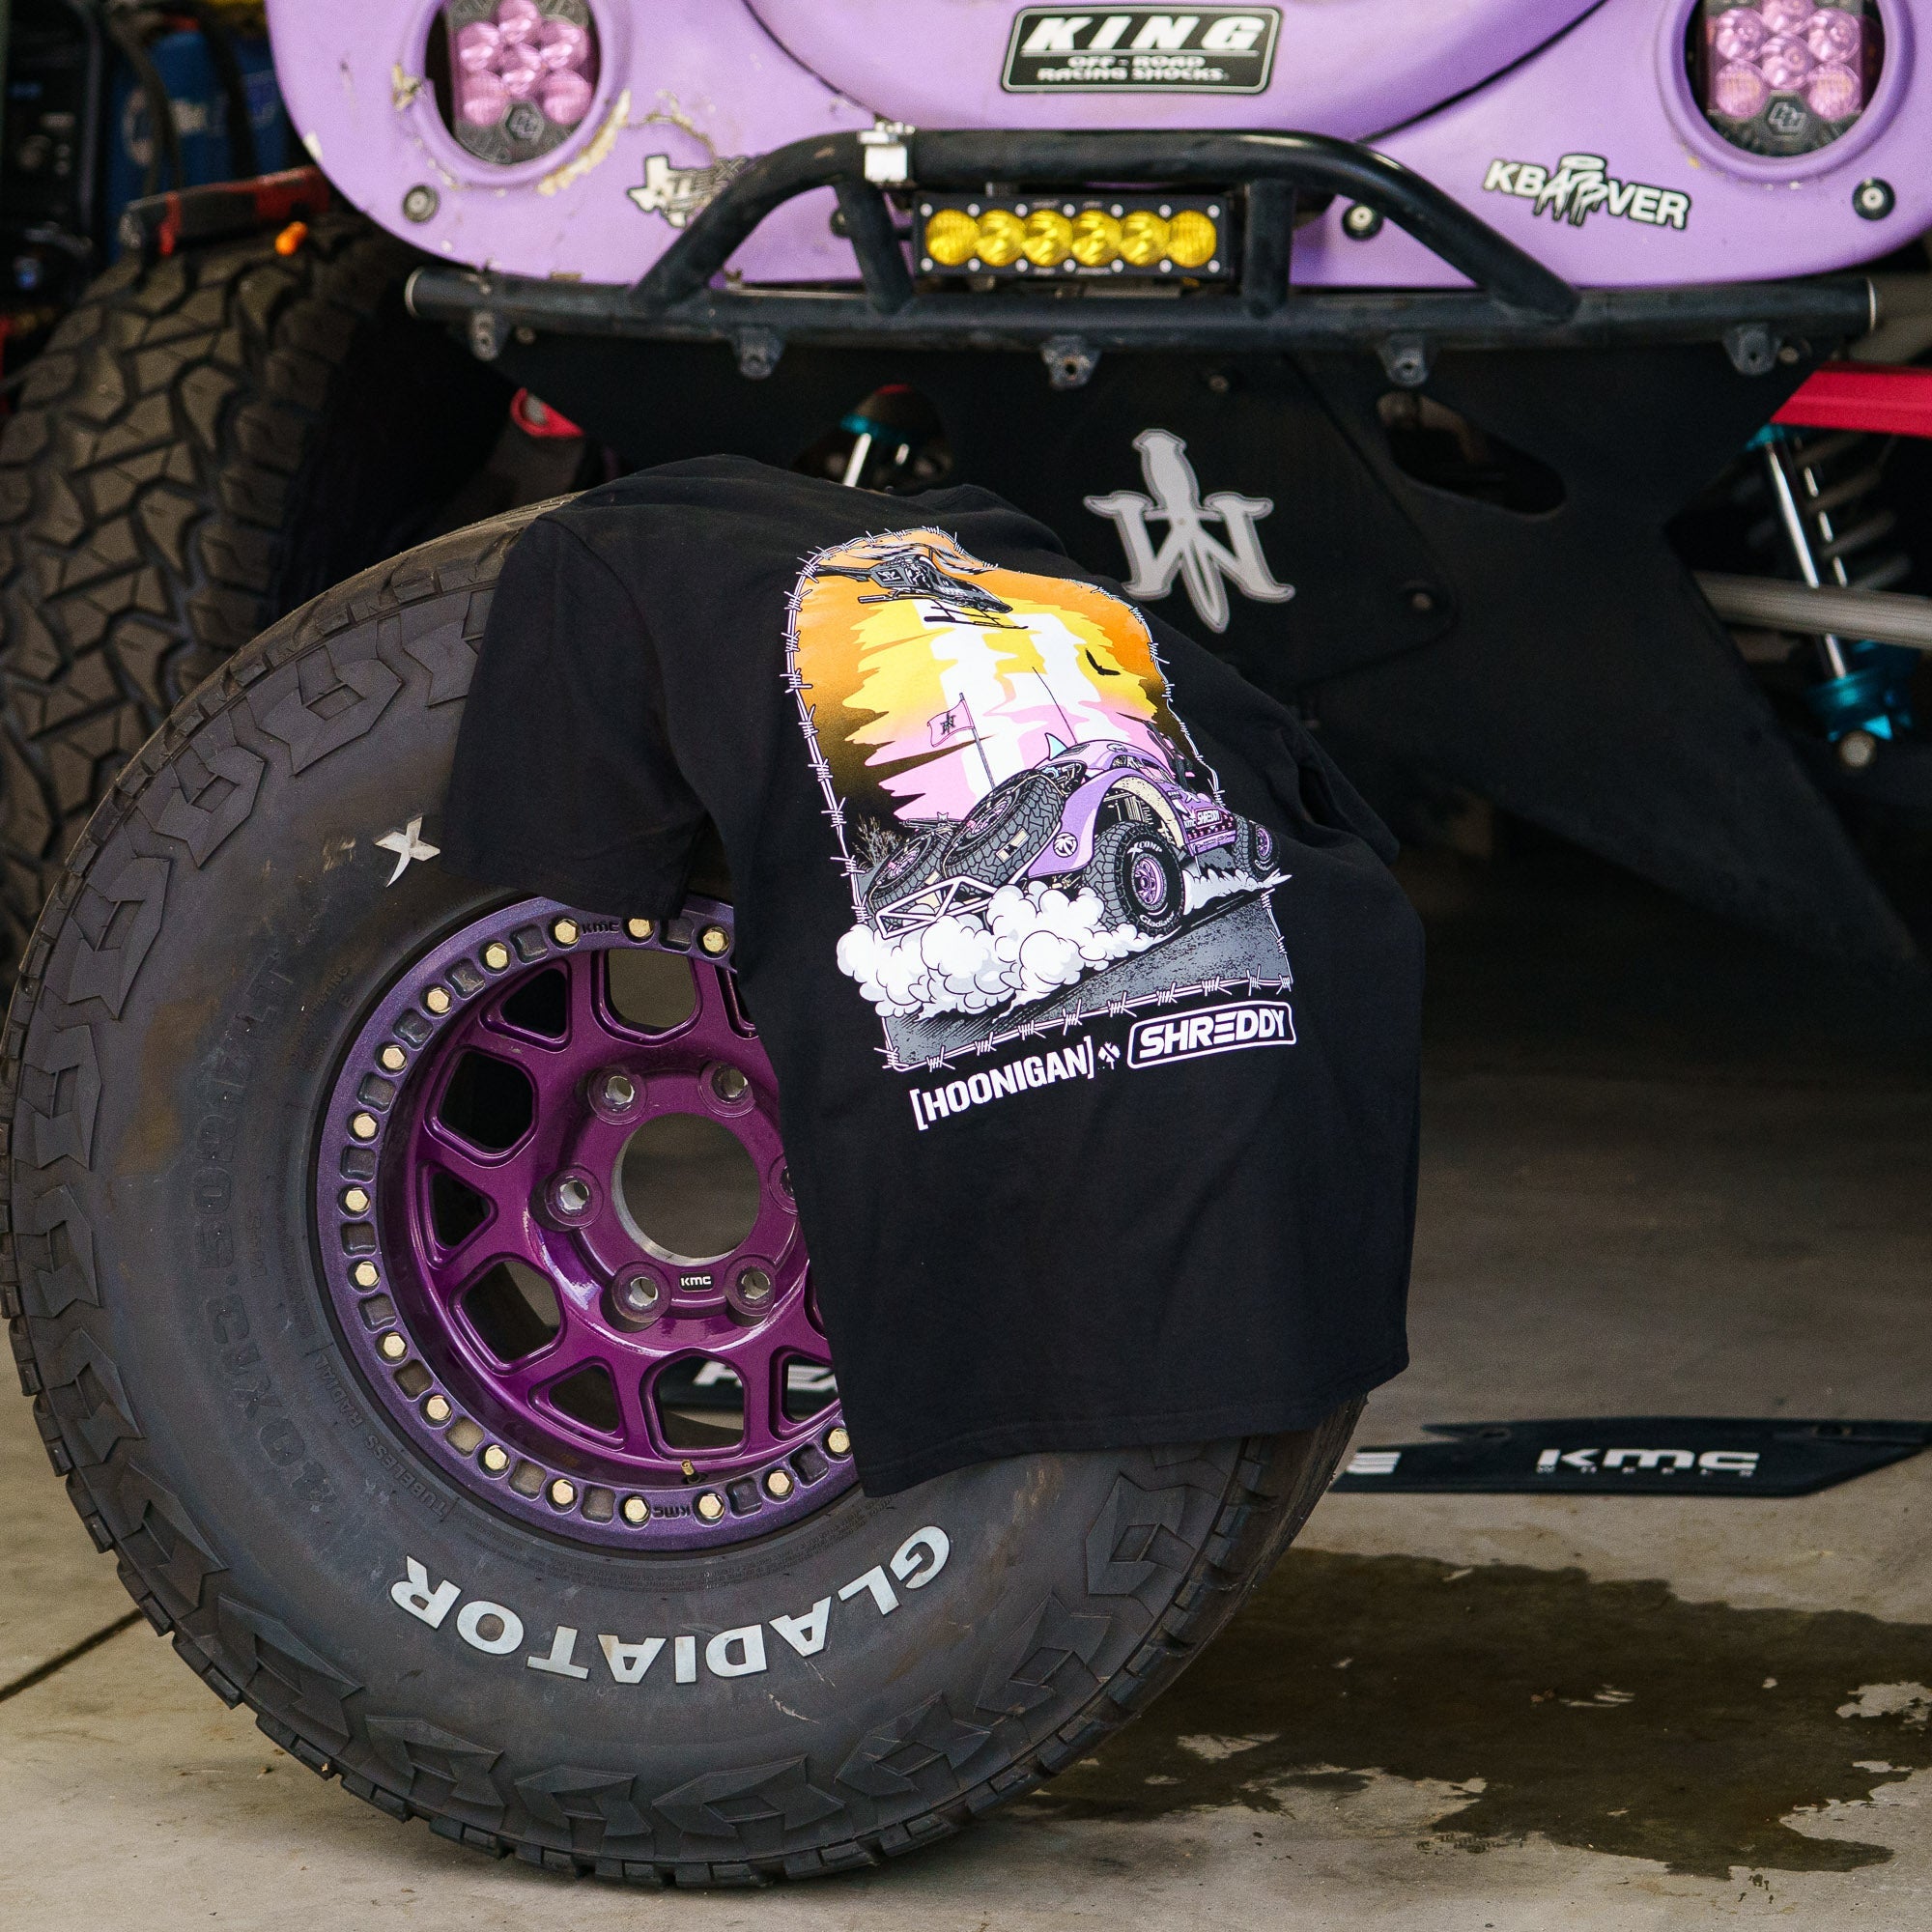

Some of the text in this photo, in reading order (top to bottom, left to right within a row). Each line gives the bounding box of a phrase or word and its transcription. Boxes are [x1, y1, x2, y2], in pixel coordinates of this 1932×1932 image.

[1021, 15, 1266, 51] KING
[1037, 68, 1127, 80] RACING
[1139, 1009, 1286, 1059] SHREDDY
[680, 1275, 712, 1287] KMC
[314, 1353, 449, 1518] TUBELESS RADIAL
[1537, 1449, 1760, 1471] KMC
[390, 1525, 951, 1684] GLADIATOR
